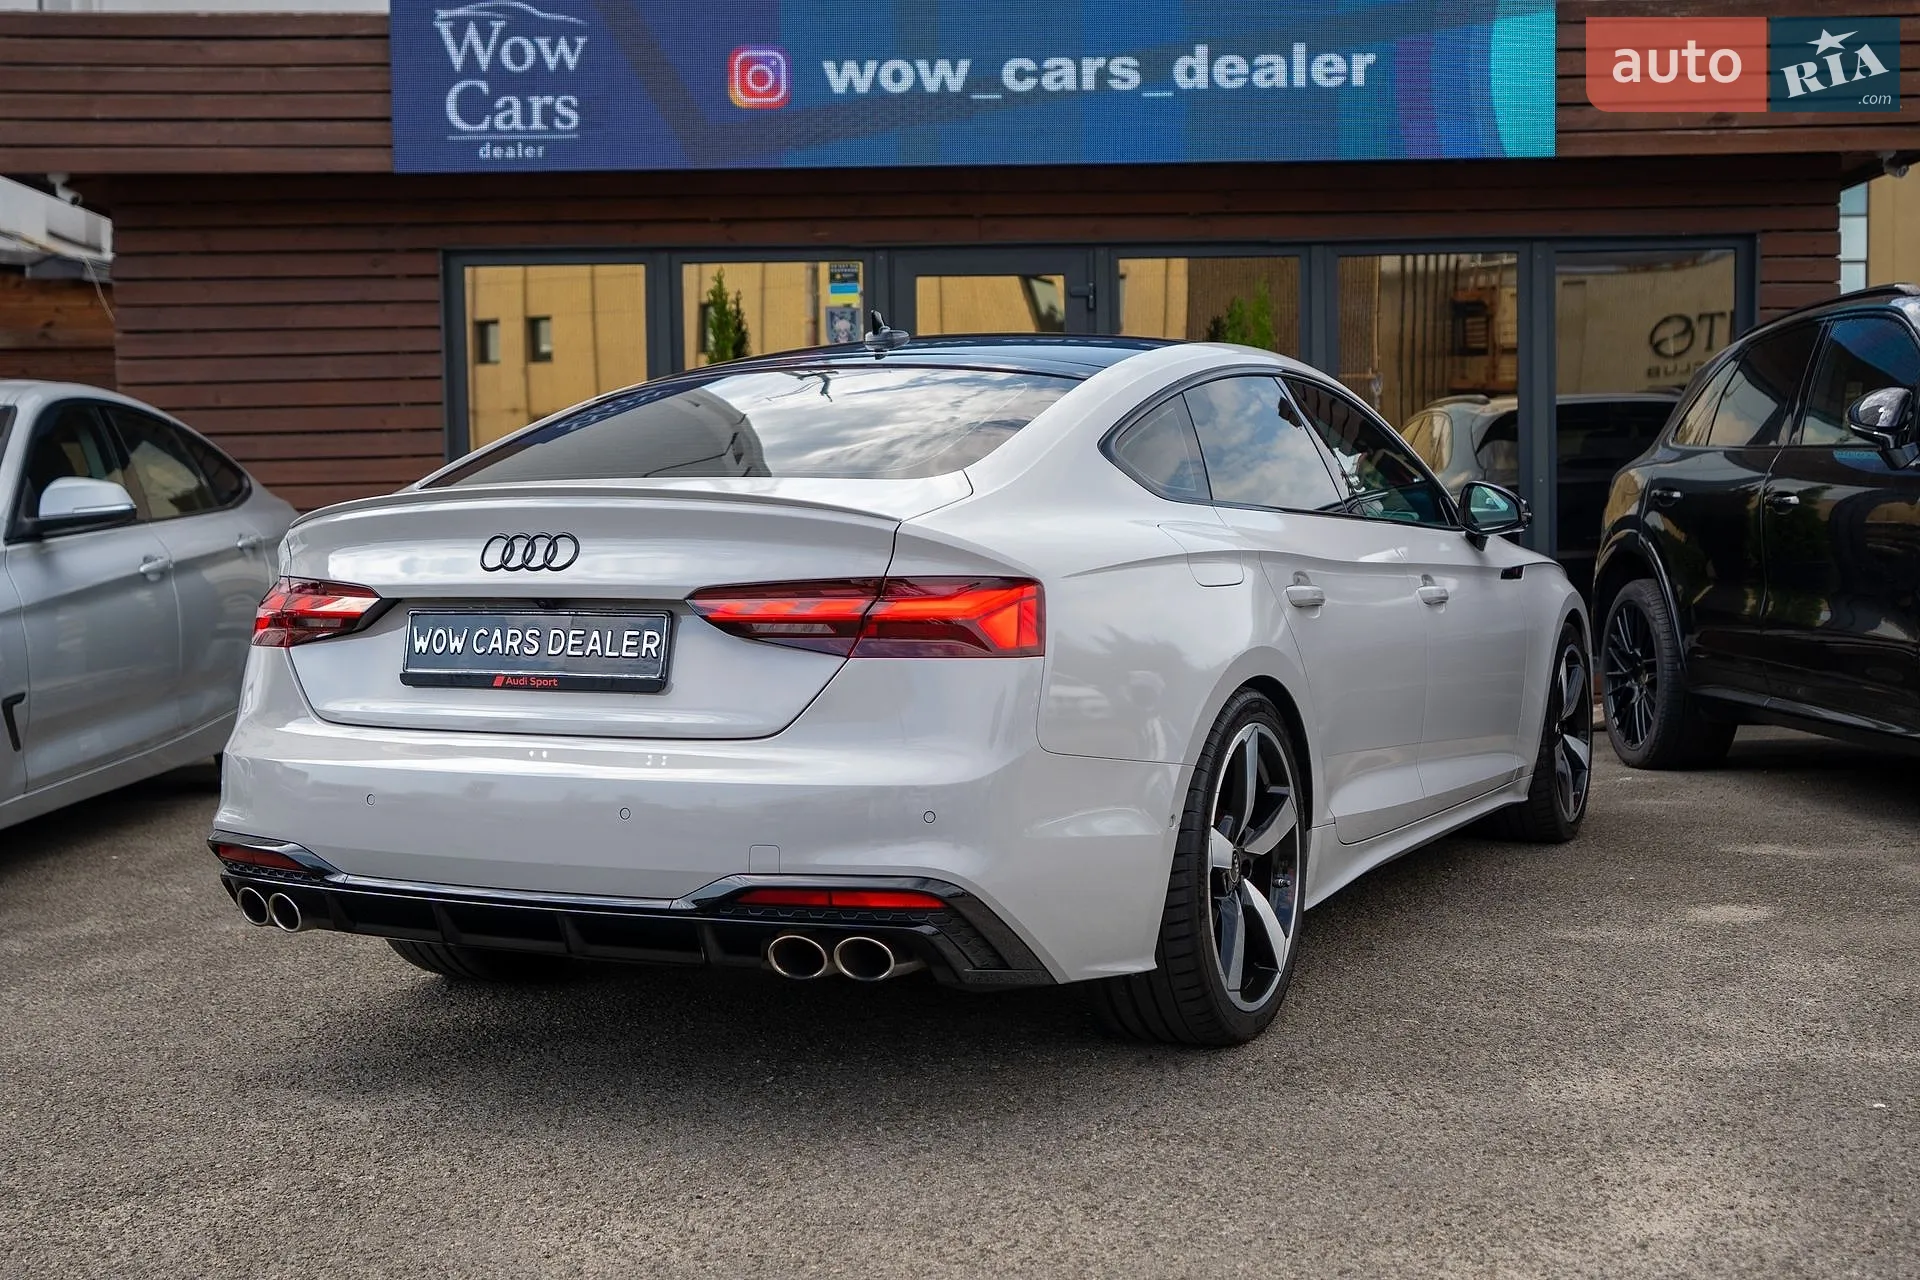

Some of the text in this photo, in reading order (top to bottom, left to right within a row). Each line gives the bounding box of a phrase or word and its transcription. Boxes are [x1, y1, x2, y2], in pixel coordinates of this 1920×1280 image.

[435, 20, 588, 72] Wow
[823, 42, 1376, 99] wow_cars_dealer
[446, 80, 579, 131] Cars
[478, 142, 545, 159] dealer
[413, 627, 660, 659] WOW CARS DEALER
[505, 676, 558, 689] Audi Sport
